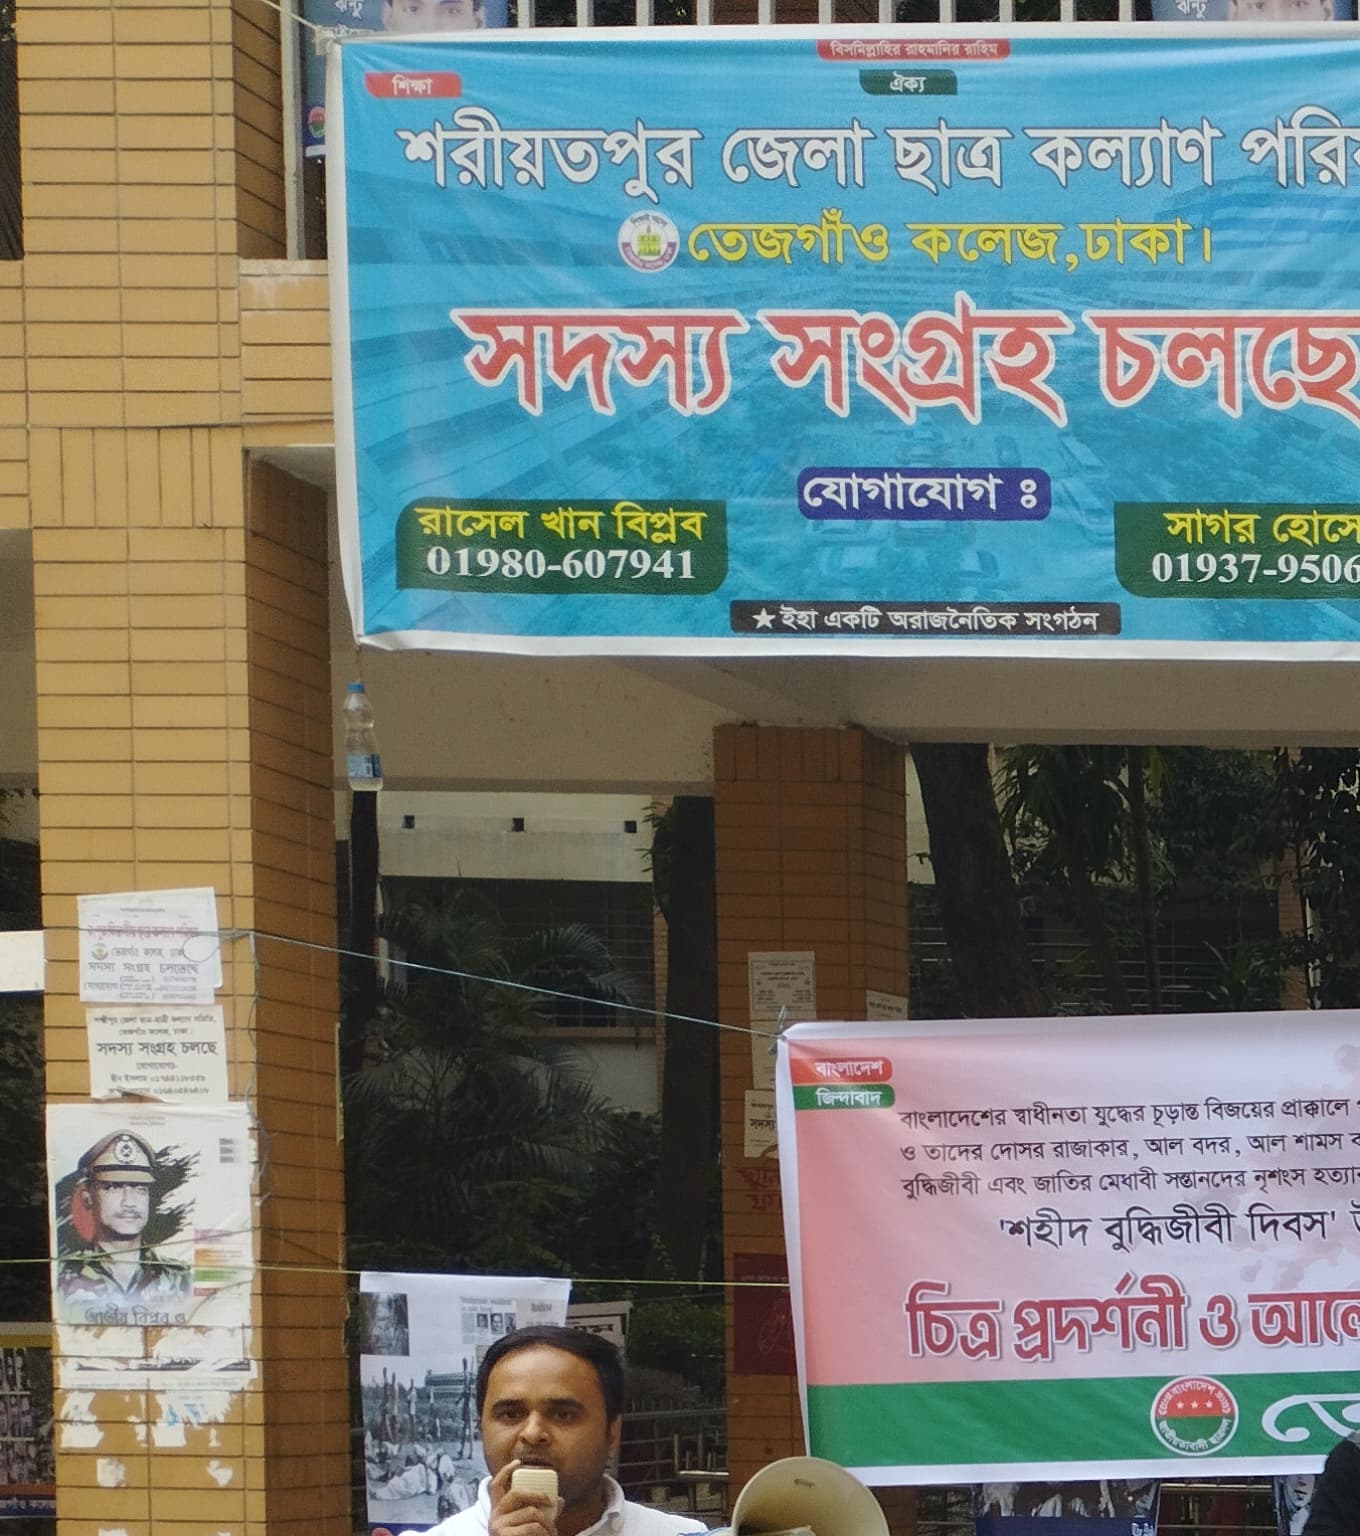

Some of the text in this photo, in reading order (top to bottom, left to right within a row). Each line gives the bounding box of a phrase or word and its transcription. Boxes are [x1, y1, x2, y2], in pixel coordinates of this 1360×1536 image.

[392, 75, 433, 96] শিক্ষা
[890, 71, 927, 93] ঐক্য
[397, 106, 702, 204] শরীয়তপুর
[723, 118, 877, 188] জেলা
[888, 118, 1011, 195] ছাত্র
[1025, 118, 1223, 188] কল্যাণ
[688, 208, 888, 265] তেজগাঁও
[451, 308, 749, 415] সদস্য
[757, 290, 1074, 427] সংগ্রহ
[804, 471, 1003, 512] যোগাযোগ
[415, 501, 707, 544] রাসেল খান বিপ্লব
[1164, 507, 1258, 544] সাগর
[427, 546, 695, 579] 01980-607941
[780, 604, 1100, 632] ইহা একটি অরাজনৈতিক সংগঠন
[97, 1041, 217, 1056] সদস্য সংগ্রহ চলছে
[816, 1059, 883, 1077] বাংলাদেশ
[816, 1088, 882, 1106] জিন্দাবাদ
[899, 1109, 1006, 1128] বাংলাদেশের
[1014, 1103, 1087, 1127] স্বাধীনতা
[1093, 1106, 1144, 1127] যুদ্ধের
[1153, 1103, 1199, 1126] চূড়ান্ত
[1205, 1098, 1274, 1120] বিজয়ের
[900, 1148, 915, 1161] ও
[923, 1143, 982, 1162] তাদের
[990, 1141, 1044, 1161] দোসর
[1145, 1137, 1183, 1155] আল
[1246, 1132, 1285, 1151] আল
[1293, 1131, 1342, 1151] শামস
[902, 1172, 980, 1199] বুদ্ধিজীবী
[988, 1177, 1025, 1194] এবং
[1033, 1171, 1092, 1193] জাতির
[1099, 1168, 1156, 1192] মেধাবী
[1165, 1167, 1247, 1189] সন্তানদের
[1254, 1168, 1305, 1195] নৃশংস
[1102, 1203, 1234, 1250] বুদ্ধিজীবী
[904, 1280, 1003, 1361] চিত্র
[1011, 1272, 1189, 1362] প্রদর্শনী
[1199, 1295, 1237, 1348] ও
